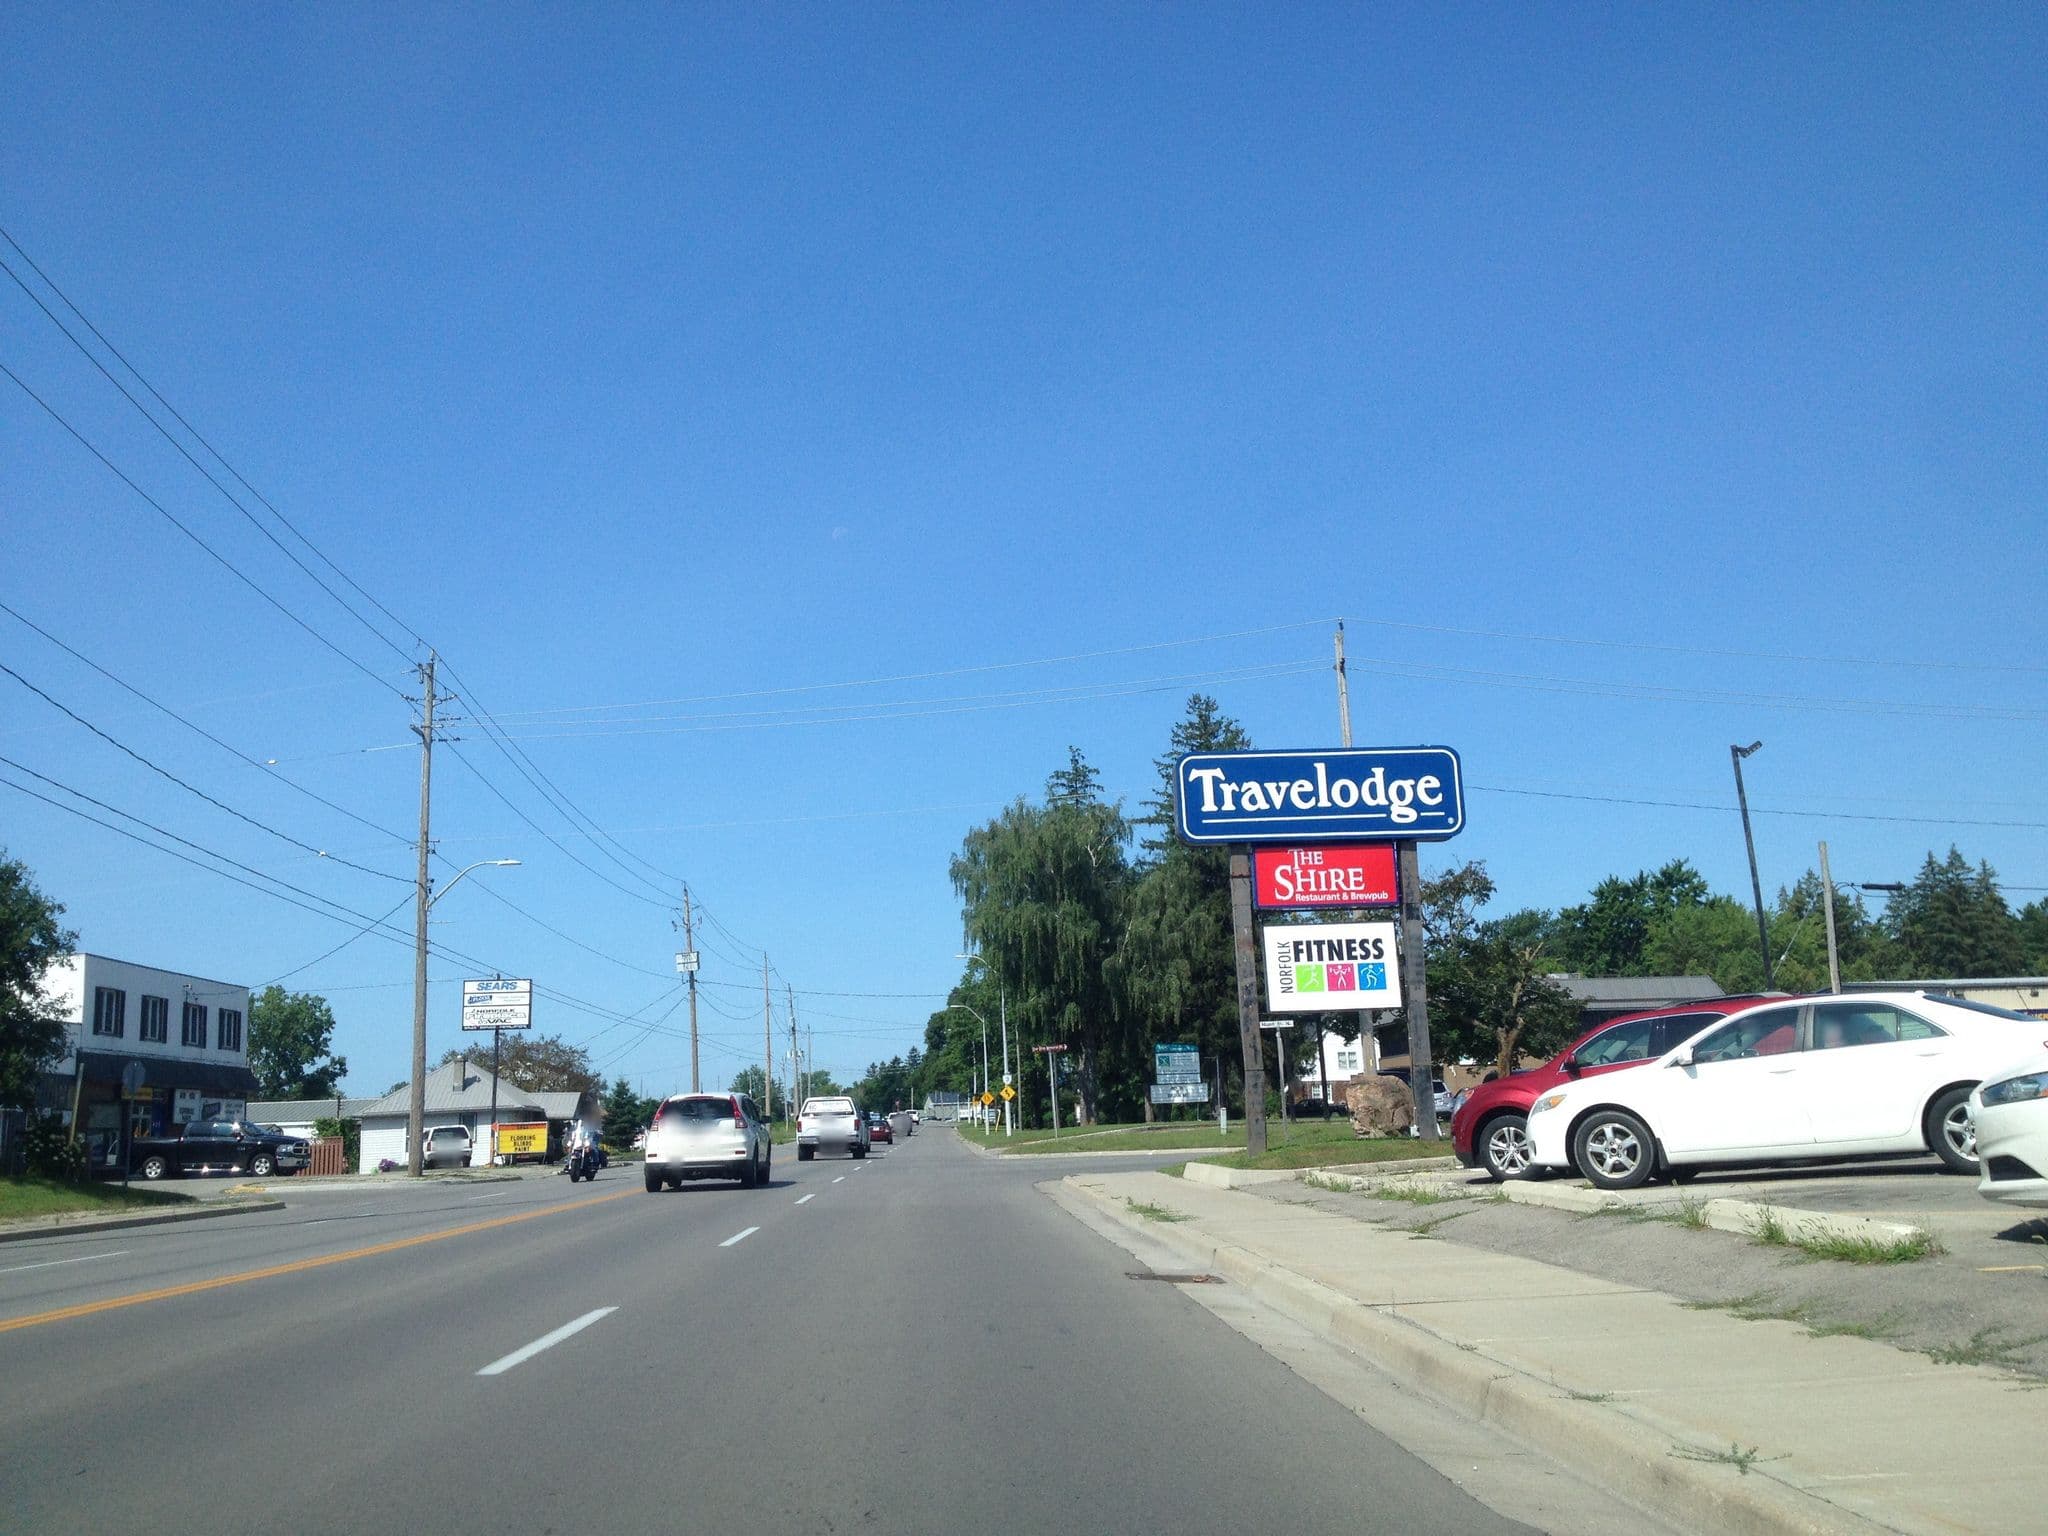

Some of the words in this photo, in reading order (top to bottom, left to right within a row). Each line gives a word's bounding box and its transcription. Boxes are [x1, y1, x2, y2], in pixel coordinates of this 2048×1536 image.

[1188, 762, 1443, 823] Travelodge
[1288, 849, 1324, 870] THE
[1274, 864, 1366, 900] SHIRE
[1295, 892, 1340, 902] Restaurant
[1342, 892, 1349, 901] &
[1351, 890, 1389, 901] Brewpub
[1292, 937, 1385, 962] FITNESS
[1277, 941, 1293, 994] NORFOLK
[476, 981, 518, 991] SEARS
